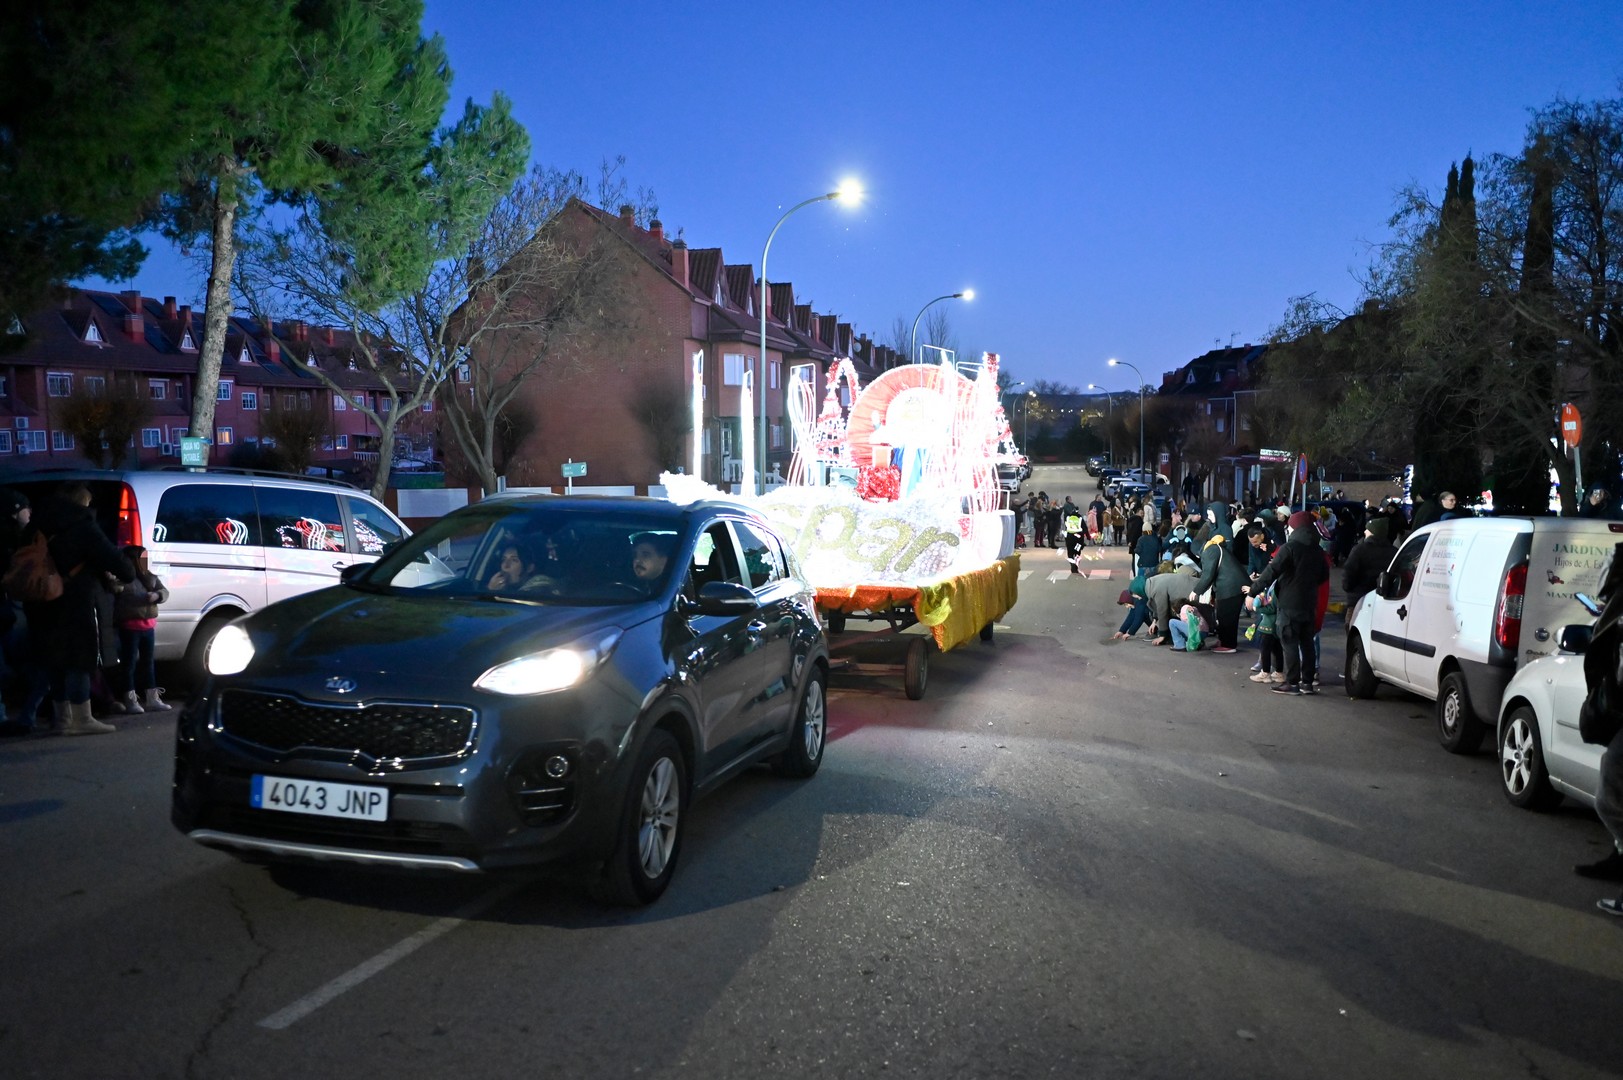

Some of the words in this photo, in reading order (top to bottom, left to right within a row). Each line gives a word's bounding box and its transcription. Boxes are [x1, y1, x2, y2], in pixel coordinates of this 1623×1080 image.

[183, 442, 193, 450] AGUA
[194, 442, 200, 450] NO
[184, 453, 200, 461] POTABLE
[1553, 543, 1611, 556] JARDINE
[1555, 557, 1572, 568] Hijos
[1574, 559, 1582, 568] de
[326, 679, 351, 690] KIA
[270, 782, 328, 810] 4043
[337, 789, 382, 815] JNP
